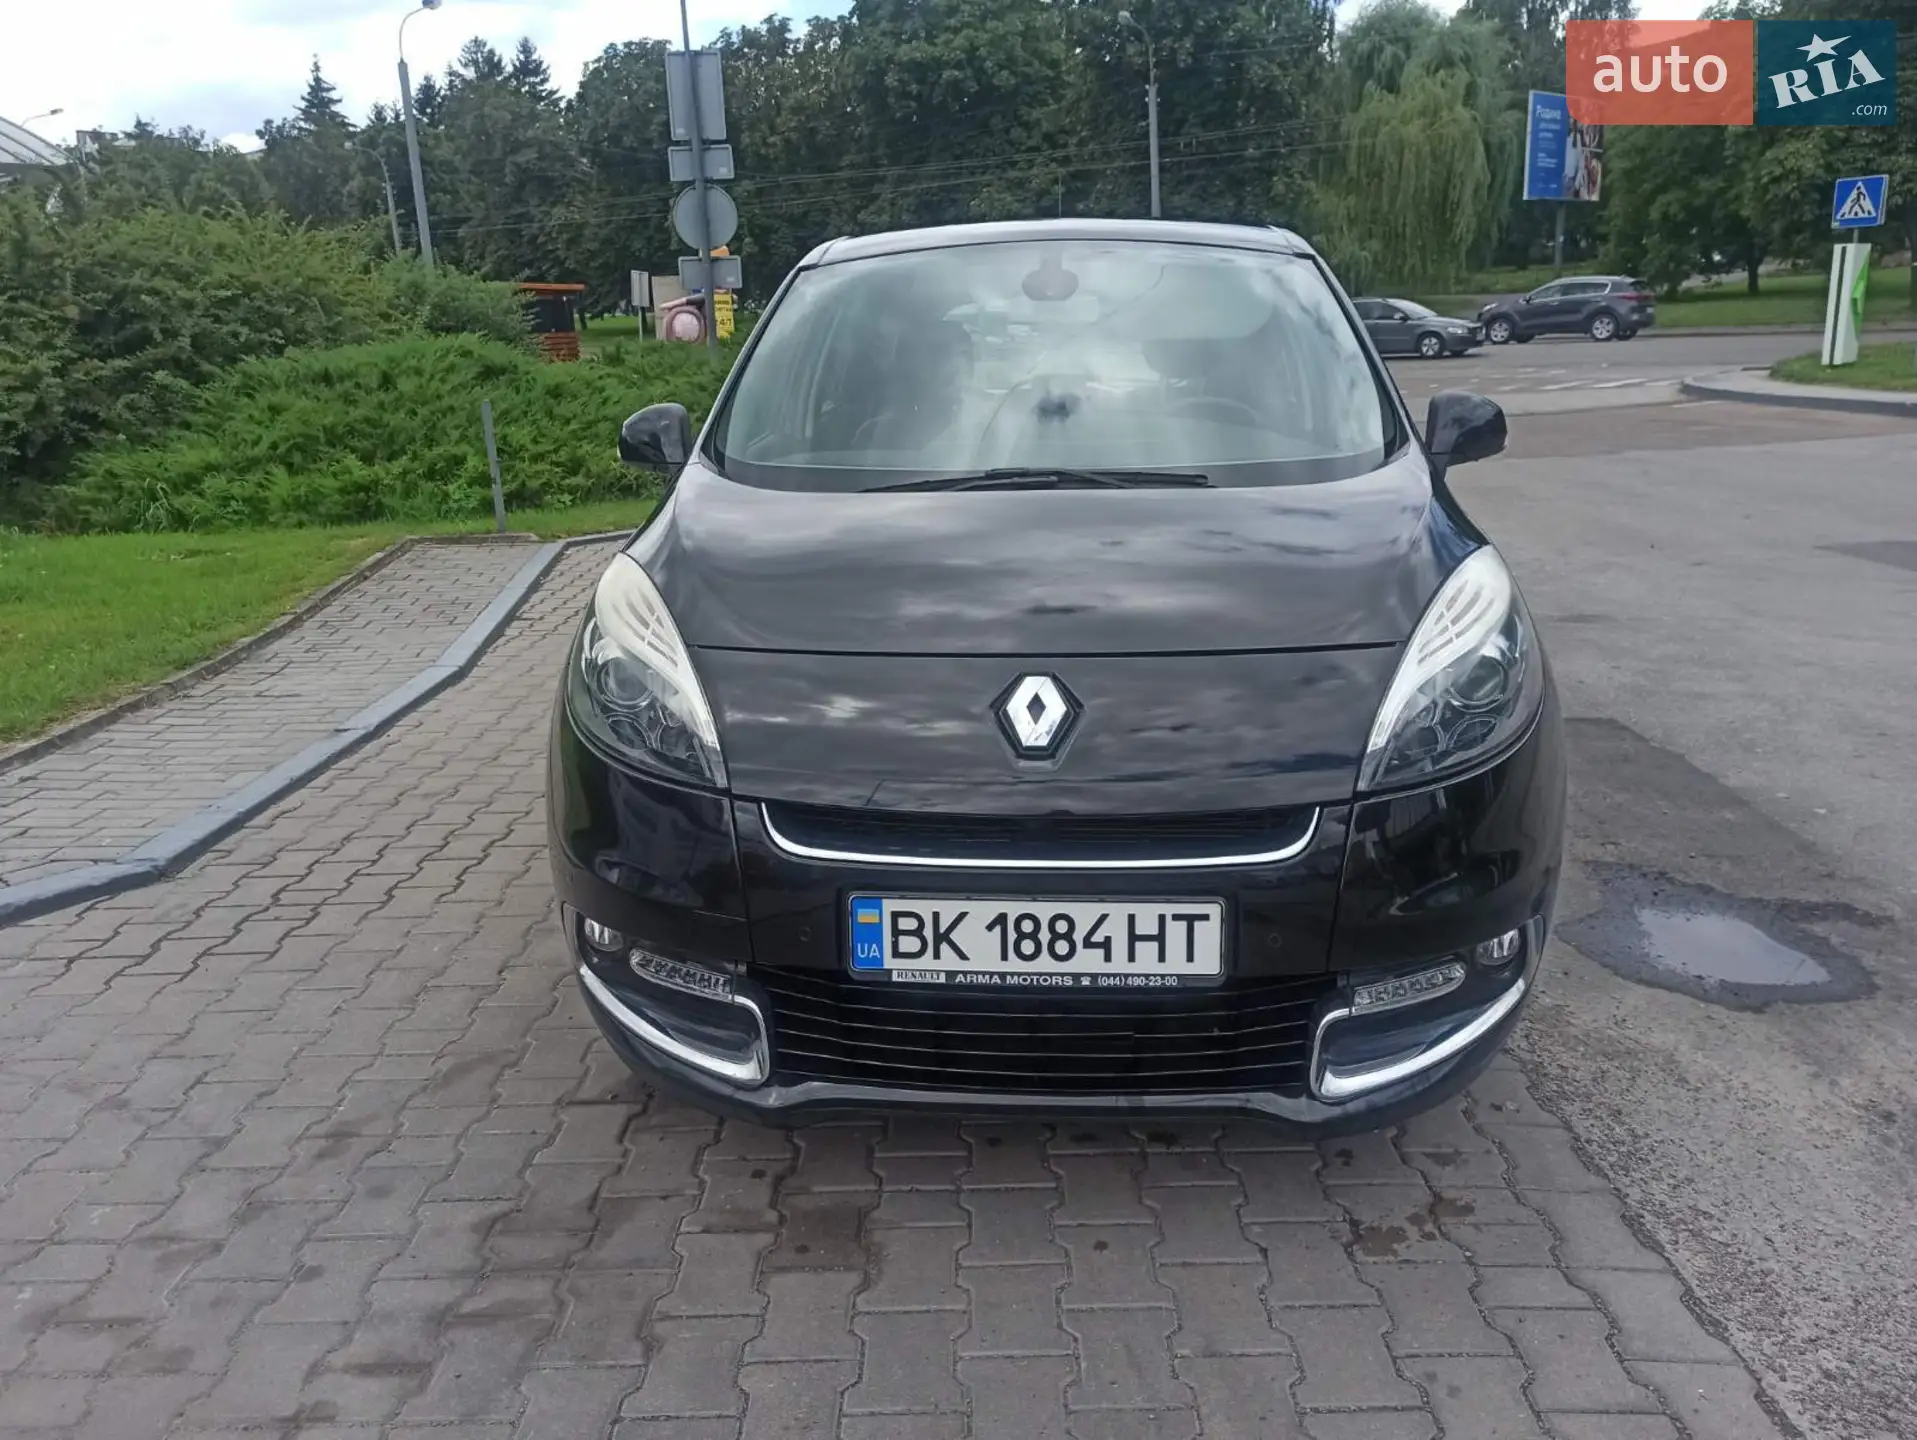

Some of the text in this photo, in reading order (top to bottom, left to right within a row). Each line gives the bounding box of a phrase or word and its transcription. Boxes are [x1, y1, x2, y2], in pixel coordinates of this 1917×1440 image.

[890, 910, 1211, 963] BK 1884 HT
[857, 944, 880, 959] UA
[896, 970, 941, 982] RENAULT
[955, 973, 1001, 984] ARMA
[1006, 974, 1073, 986] MOTORS
